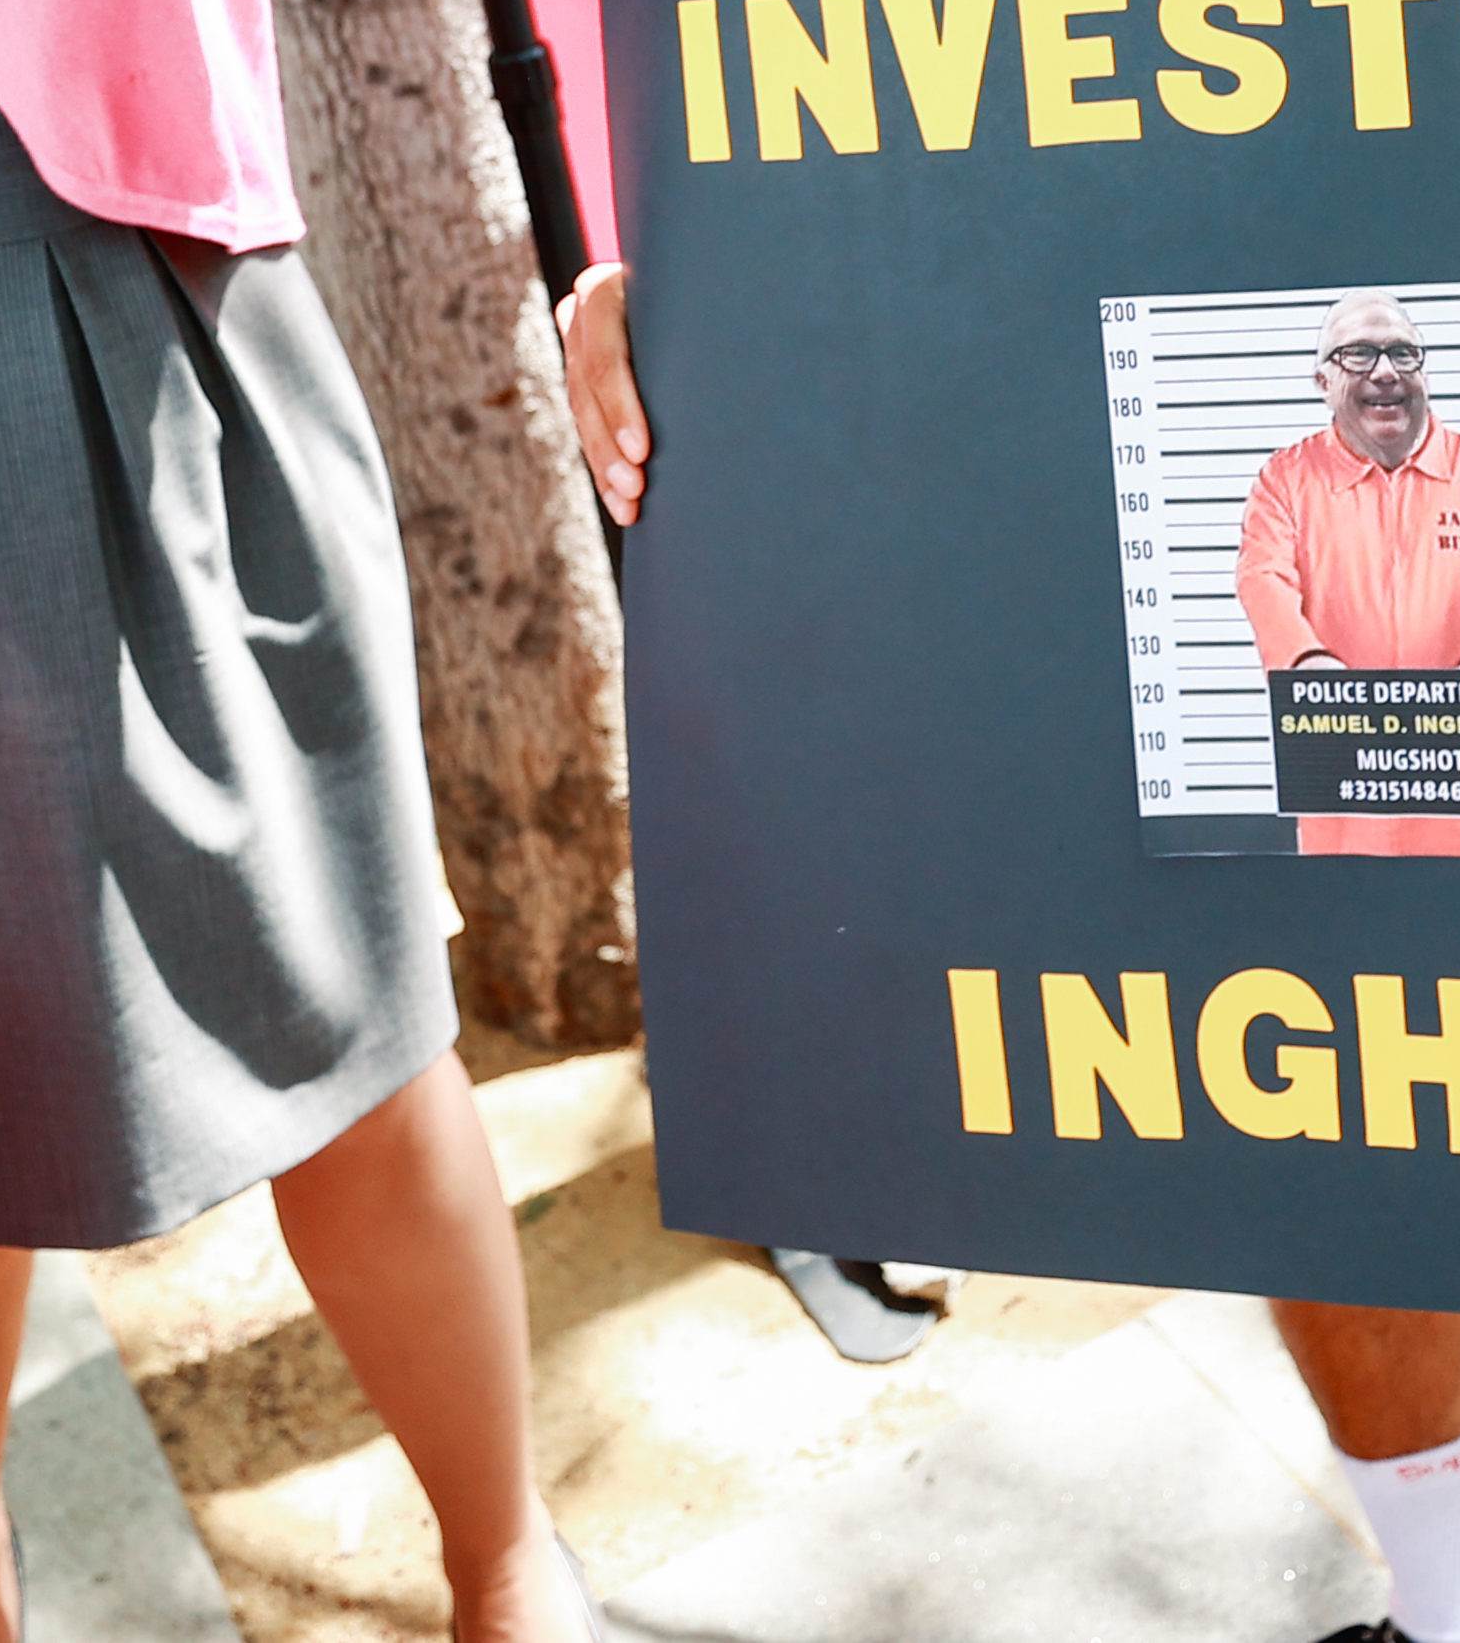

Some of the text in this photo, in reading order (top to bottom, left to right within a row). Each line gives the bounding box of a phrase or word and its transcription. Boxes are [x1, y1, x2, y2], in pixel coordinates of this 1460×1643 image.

[1101, 302, 1137, 323] 200
[1108, 349, 1138, 370] 190
[1112, 397, 1142, 418] 180
[1116, 444, 1146, 465] 170
[1120, 492, 1149, 513] 160
[1124, 540, 1153, 561] 150
[1126, 587, 1157, 608] 140
[1130, 635, 1161, 656] 130
[1134, 683, 1164, 704] 120
[1292, 681, 1368, 704] POLICE
[1280, 714, 1377, 734] SAMUEL
[1383, 715, 1408, 734] D.
[1139, 731, 1166, 752] 110
[1141, 779, 1171, 800] 100
